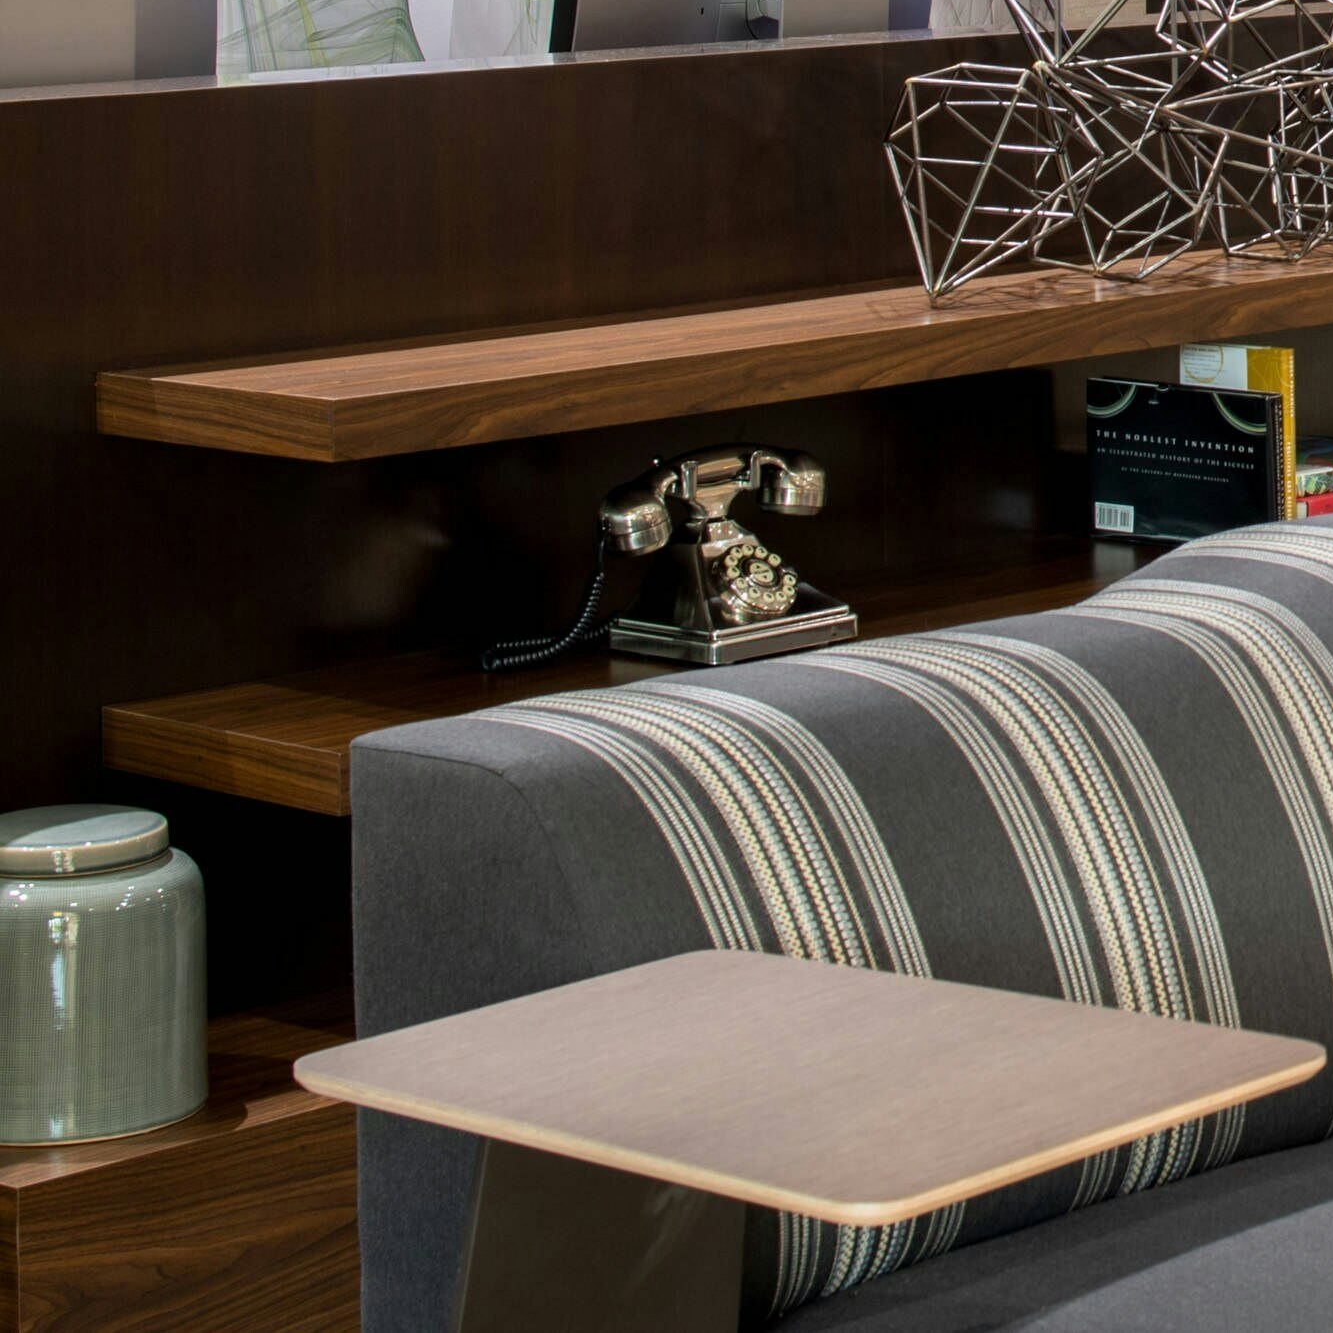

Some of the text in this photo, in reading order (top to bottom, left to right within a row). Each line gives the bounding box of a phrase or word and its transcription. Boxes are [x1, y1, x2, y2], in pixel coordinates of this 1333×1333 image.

[1096, 429, 1254, 454] THE NOBLEST INVENTION
[1109, 448, 1156, 459] ILLUSTRATED
[1160, 454, 1191, 463] HISTORY
